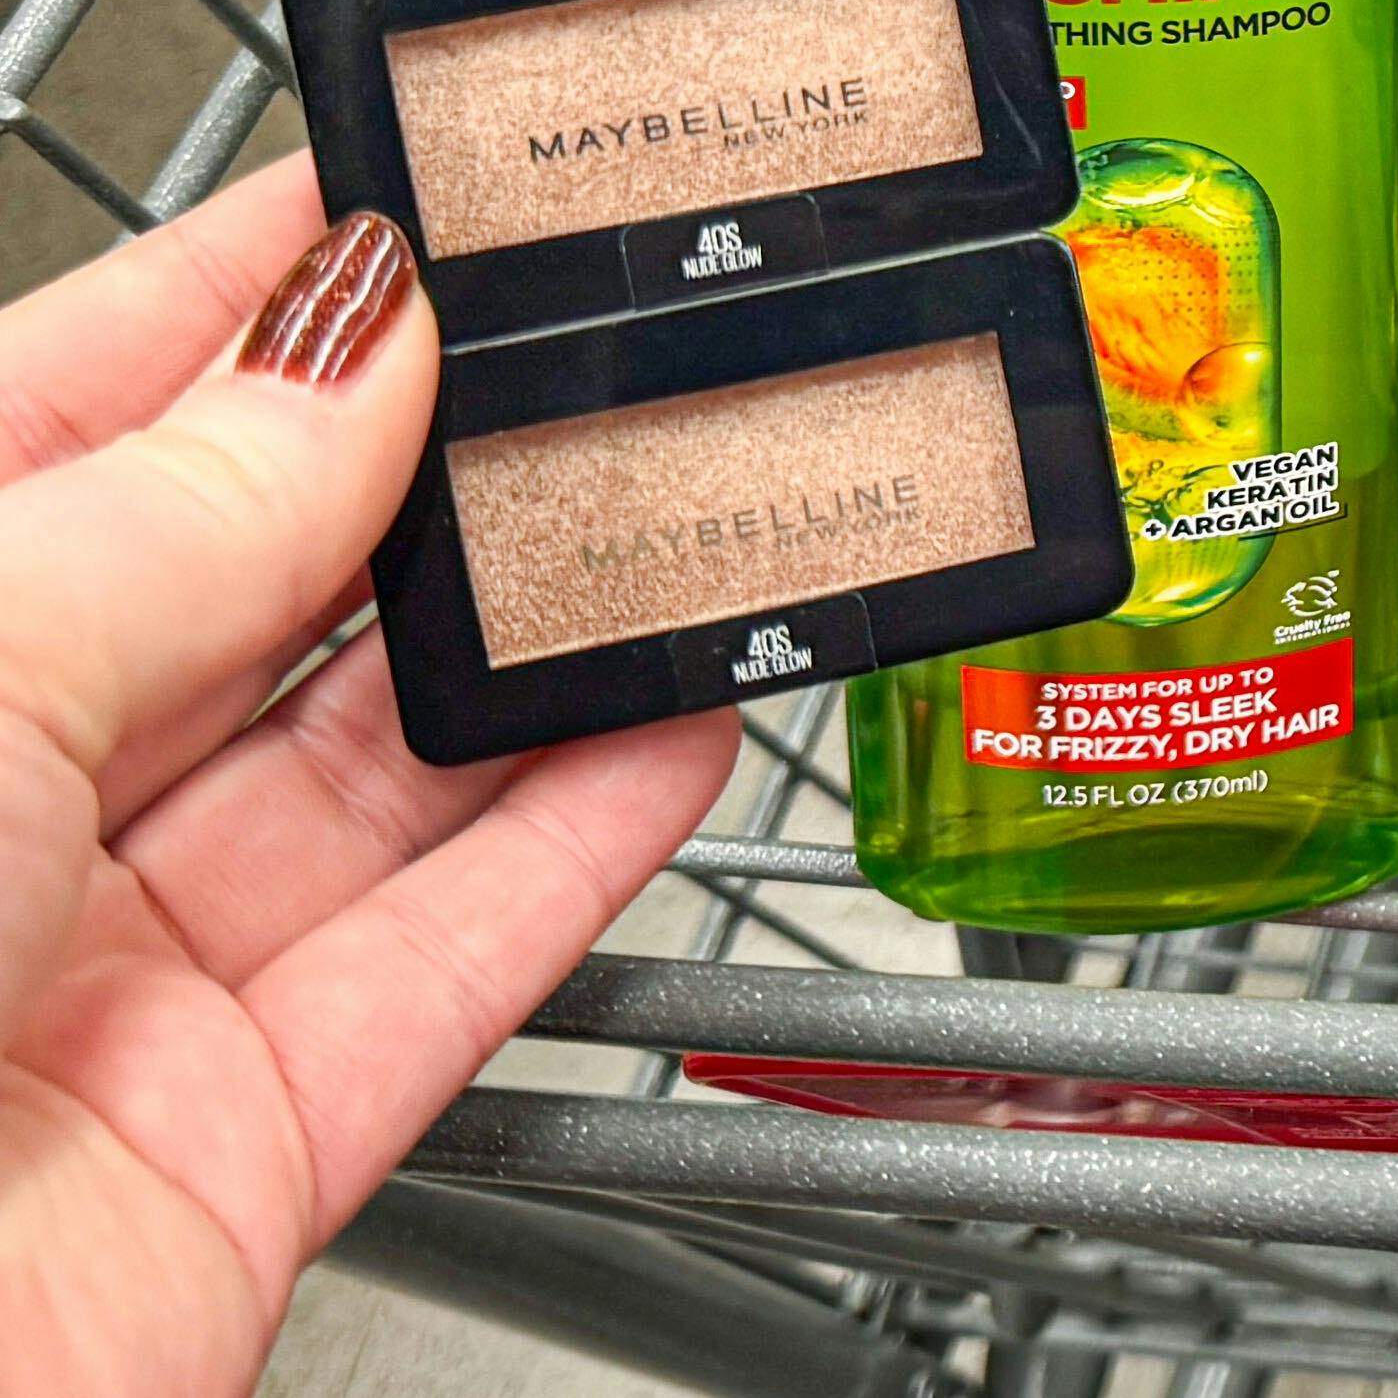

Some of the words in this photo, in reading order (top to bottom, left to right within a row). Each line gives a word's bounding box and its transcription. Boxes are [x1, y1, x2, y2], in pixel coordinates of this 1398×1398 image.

[1050, 20, 1151, 47] THING
[1161, 1, 1332, 44] SHAMPOO
[528, 77, 869, 163] MAYBELLINE
[682, 250, 724, 280] NUDE
[723, 245, 762, 273] GLOW
[1232, 445, 1336, 483] VEGAN
[1207, 468, 1337, 512] KERATIN
[581, 473, 920, 573] MAYBELLINE
[1145, 519, 1163, 539] +
[1171, 505, 1282, 539] ARGAN
[1288, 493, 1338, 521] OIL
[1274, 619, 1321, 638] Cruelty
[732, 651, 773, 685] NUDE
[772, 645, 813, 677] GLOW
[1040, 681, 1137, 701] SYSTEM
[1142, 677, 1193, 699] FOR
[1198, 673, 1234, 695] UP
[1240, 666, 1274, 686] TO
[1035, 705, 1058, 731] 3
[1065, 704, 1162, 732] DAYS
[1169, 688, 1278, 725] SLEEK
[971, 730, 1042, 759] FOR
[1049, 732, 1179, 763] FRIZZY,
[1185, 723, 1254, 756] DRY
[1262, 703, 1340, 741] HAIR
[1043, 783, 1087, 807] 12.5
[1097, 784, 1125, 807] FL
[1130, 782, 1165, 804] OZ
[1173, 768, 1270, 803] (370ml)
